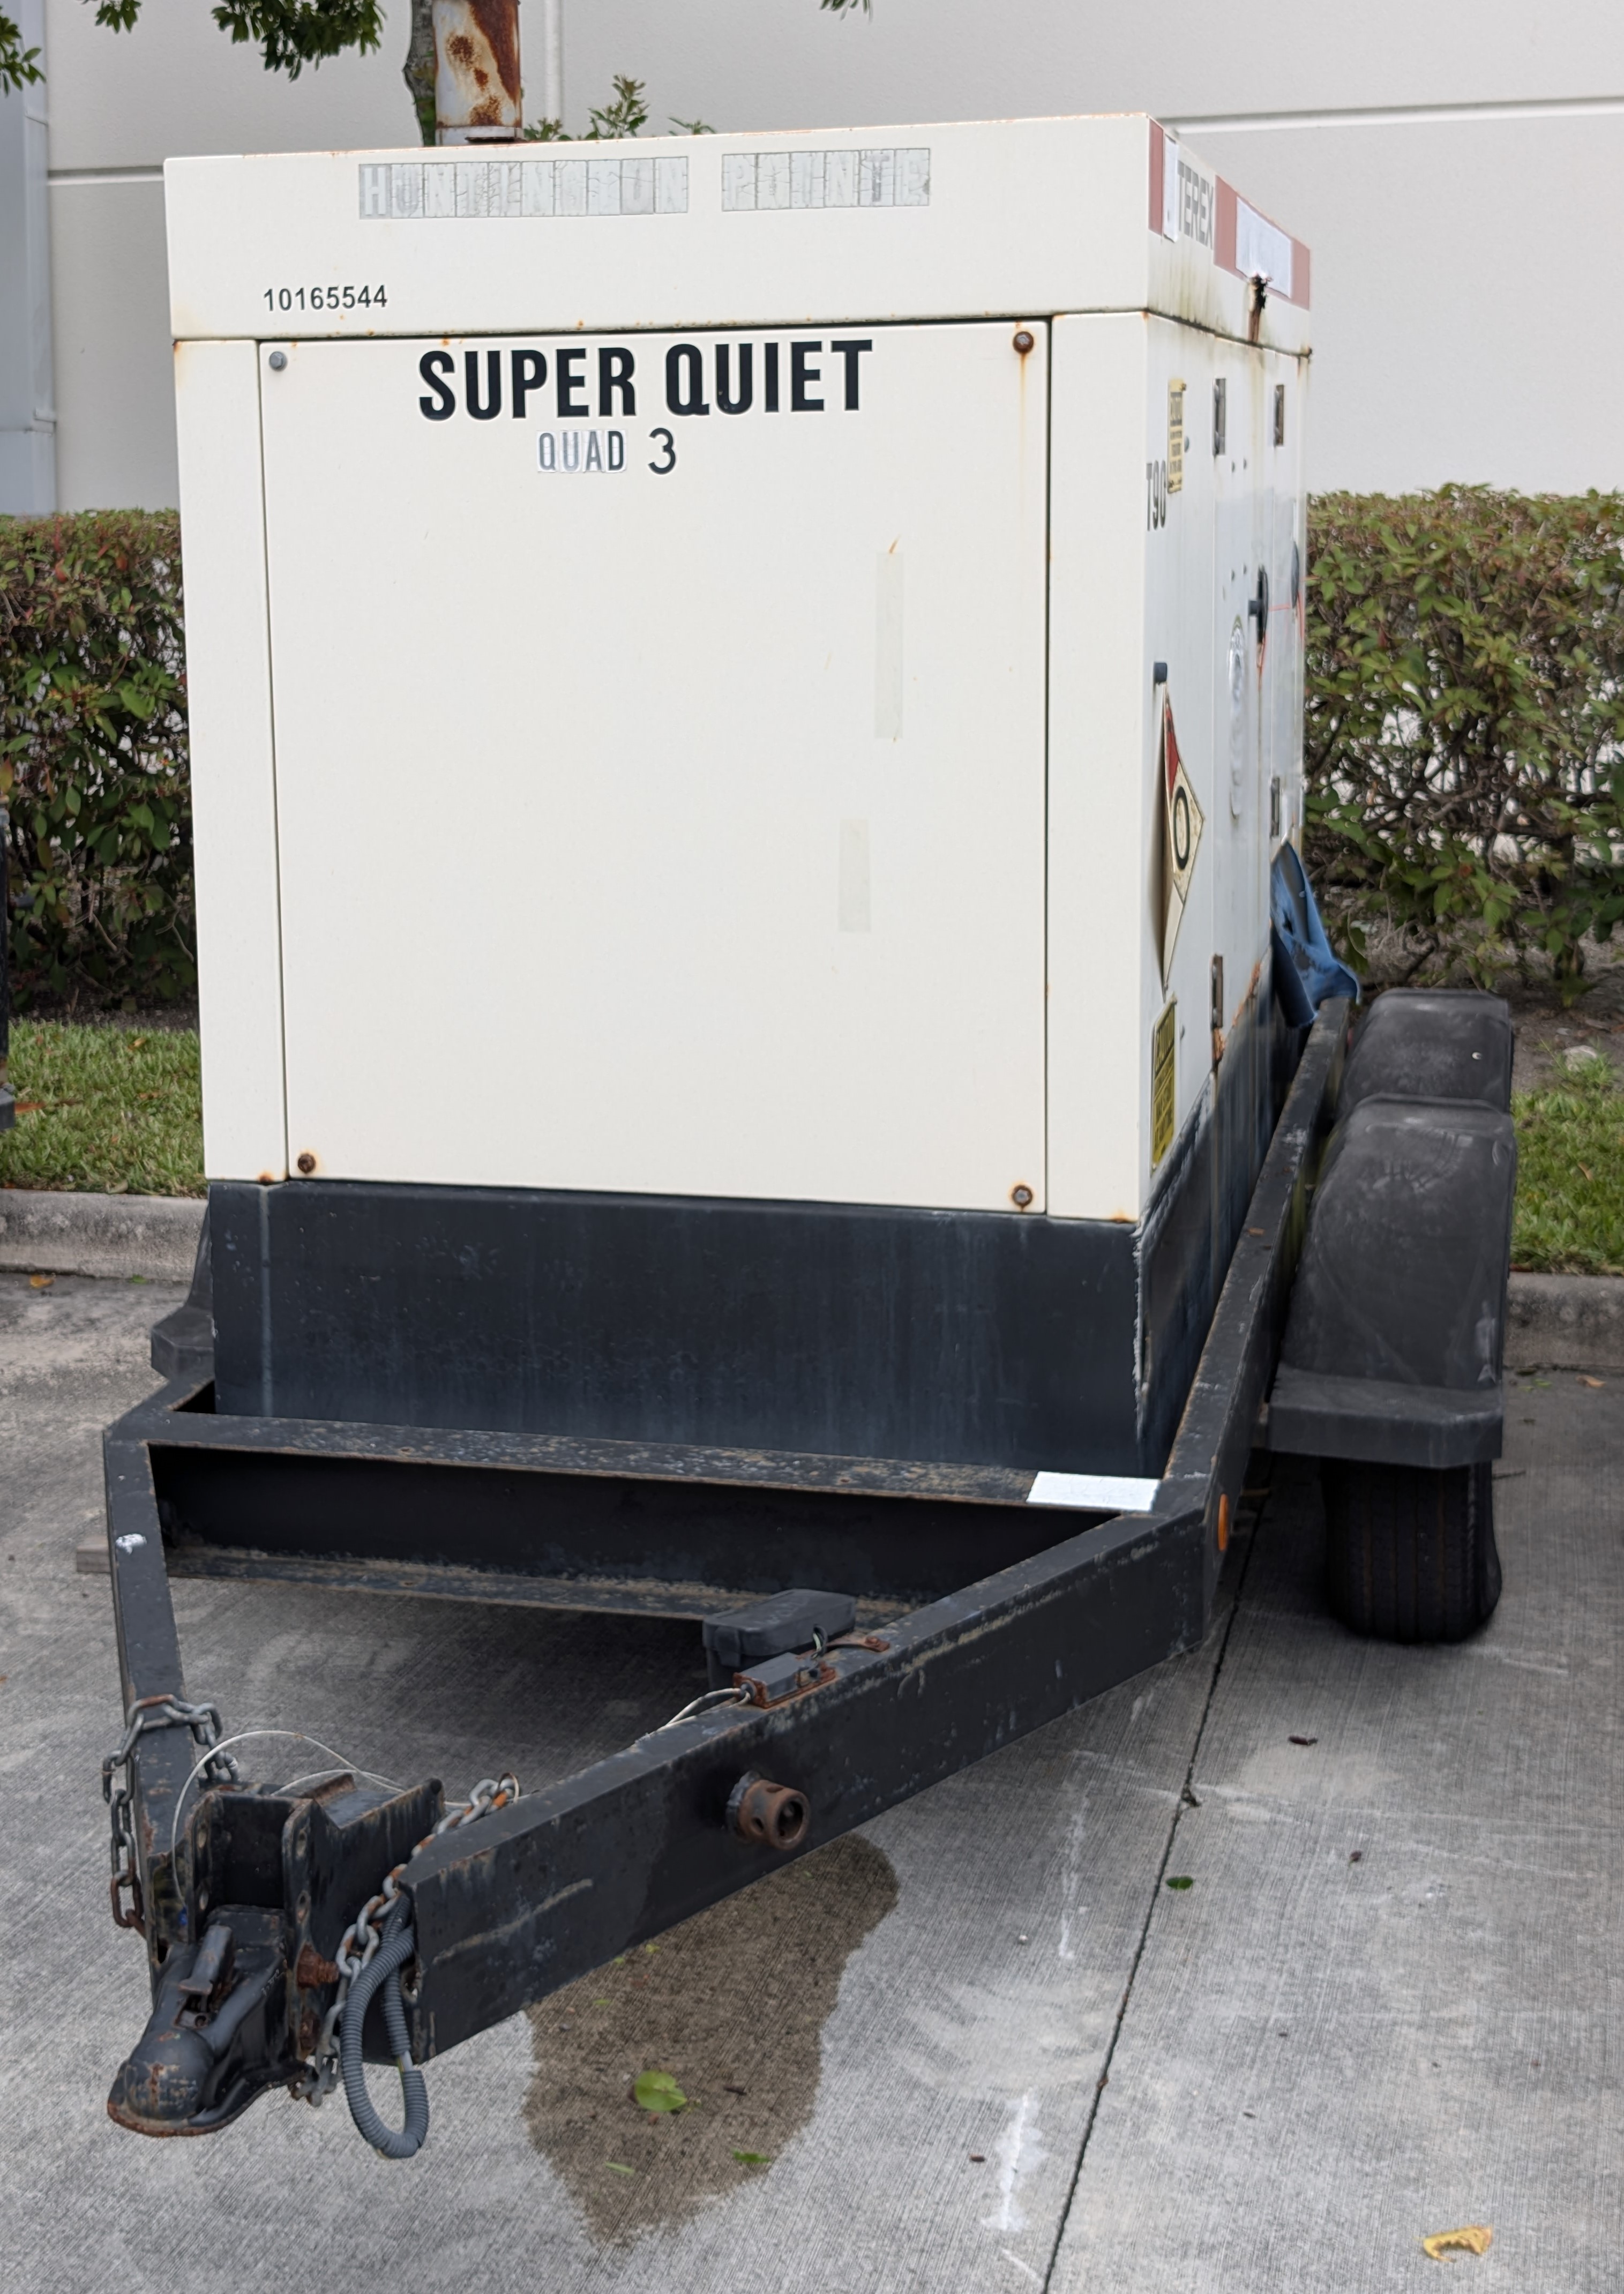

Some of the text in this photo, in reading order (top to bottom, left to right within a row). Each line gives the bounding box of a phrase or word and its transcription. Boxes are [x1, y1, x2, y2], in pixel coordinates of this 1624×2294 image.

[724, 151, 929, 209] POINTE
[1178, 160, 1214, 250] TEREX
[264, 285, 387, 311] 10165544
[419, 339, 872, 421] SUPER QUIET
[538, 428, 676, 474] QUAD 3
